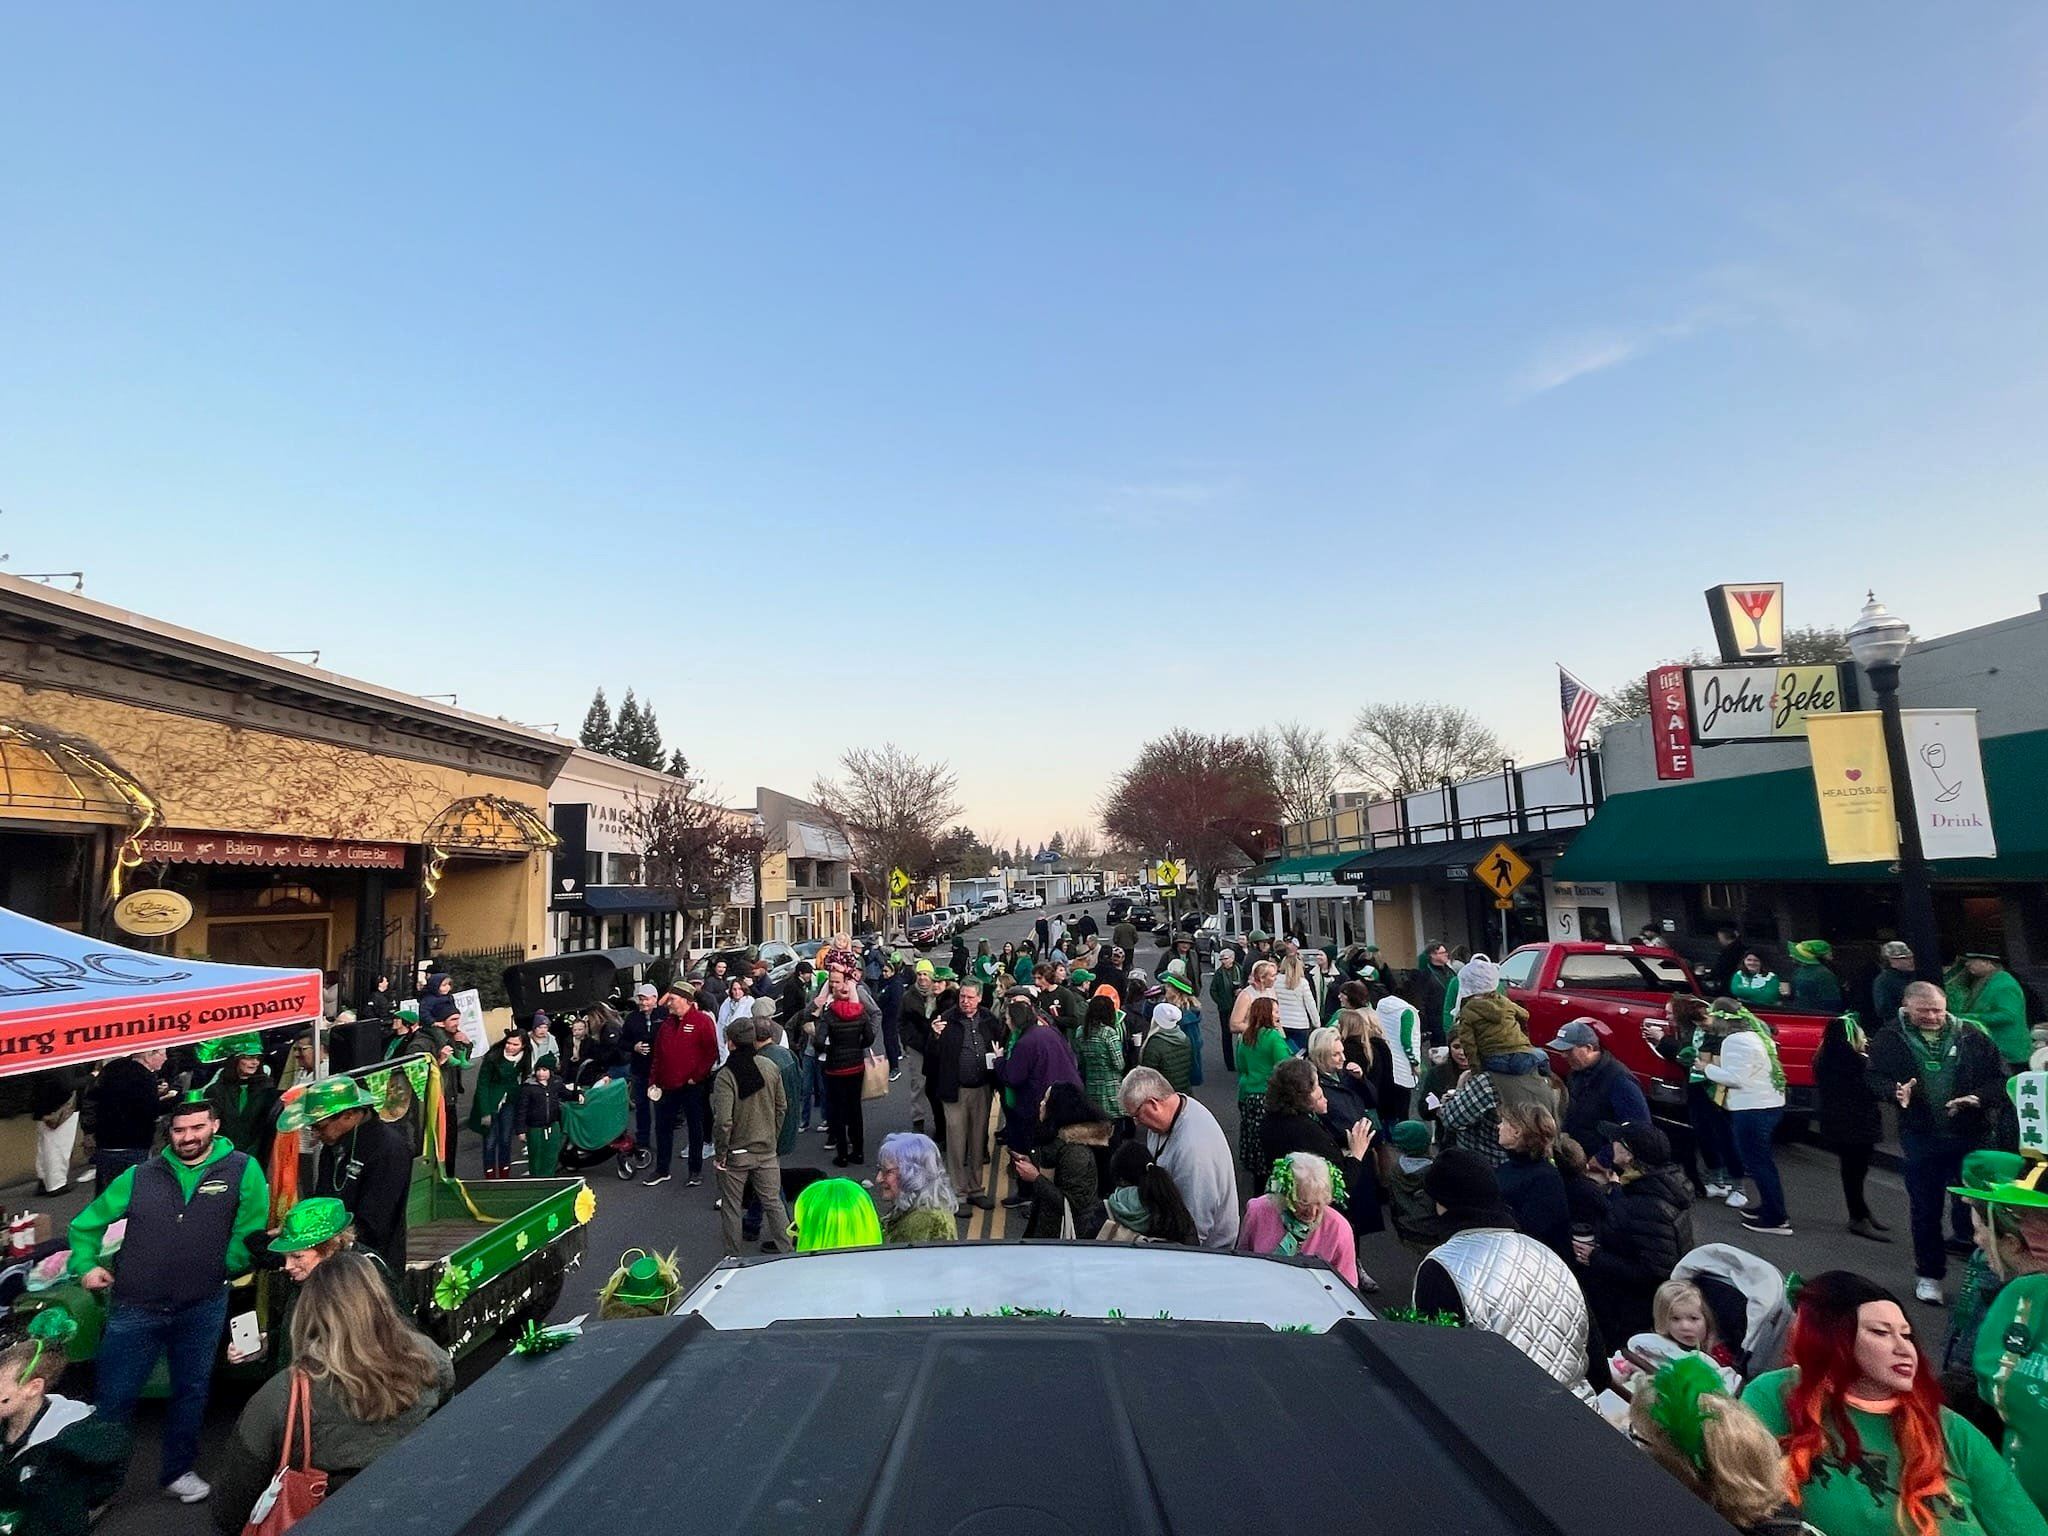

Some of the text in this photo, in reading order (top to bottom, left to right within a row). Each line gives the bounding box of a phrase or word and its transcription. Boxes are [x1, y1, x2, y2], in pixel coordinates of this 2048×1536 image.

[1704, 675, 1766, 732] John
[1776, 672, 1836, 729] Zeke
[1667, 694, 1687, 772] SALE
[590, 804, 628, 822] VANG
[1930, 813, 1984, 828] Drink
[225, 840, 264, 858] Bakery
[64, 1013, 192, 1046] running
[199, 995, 306, 1027] company
